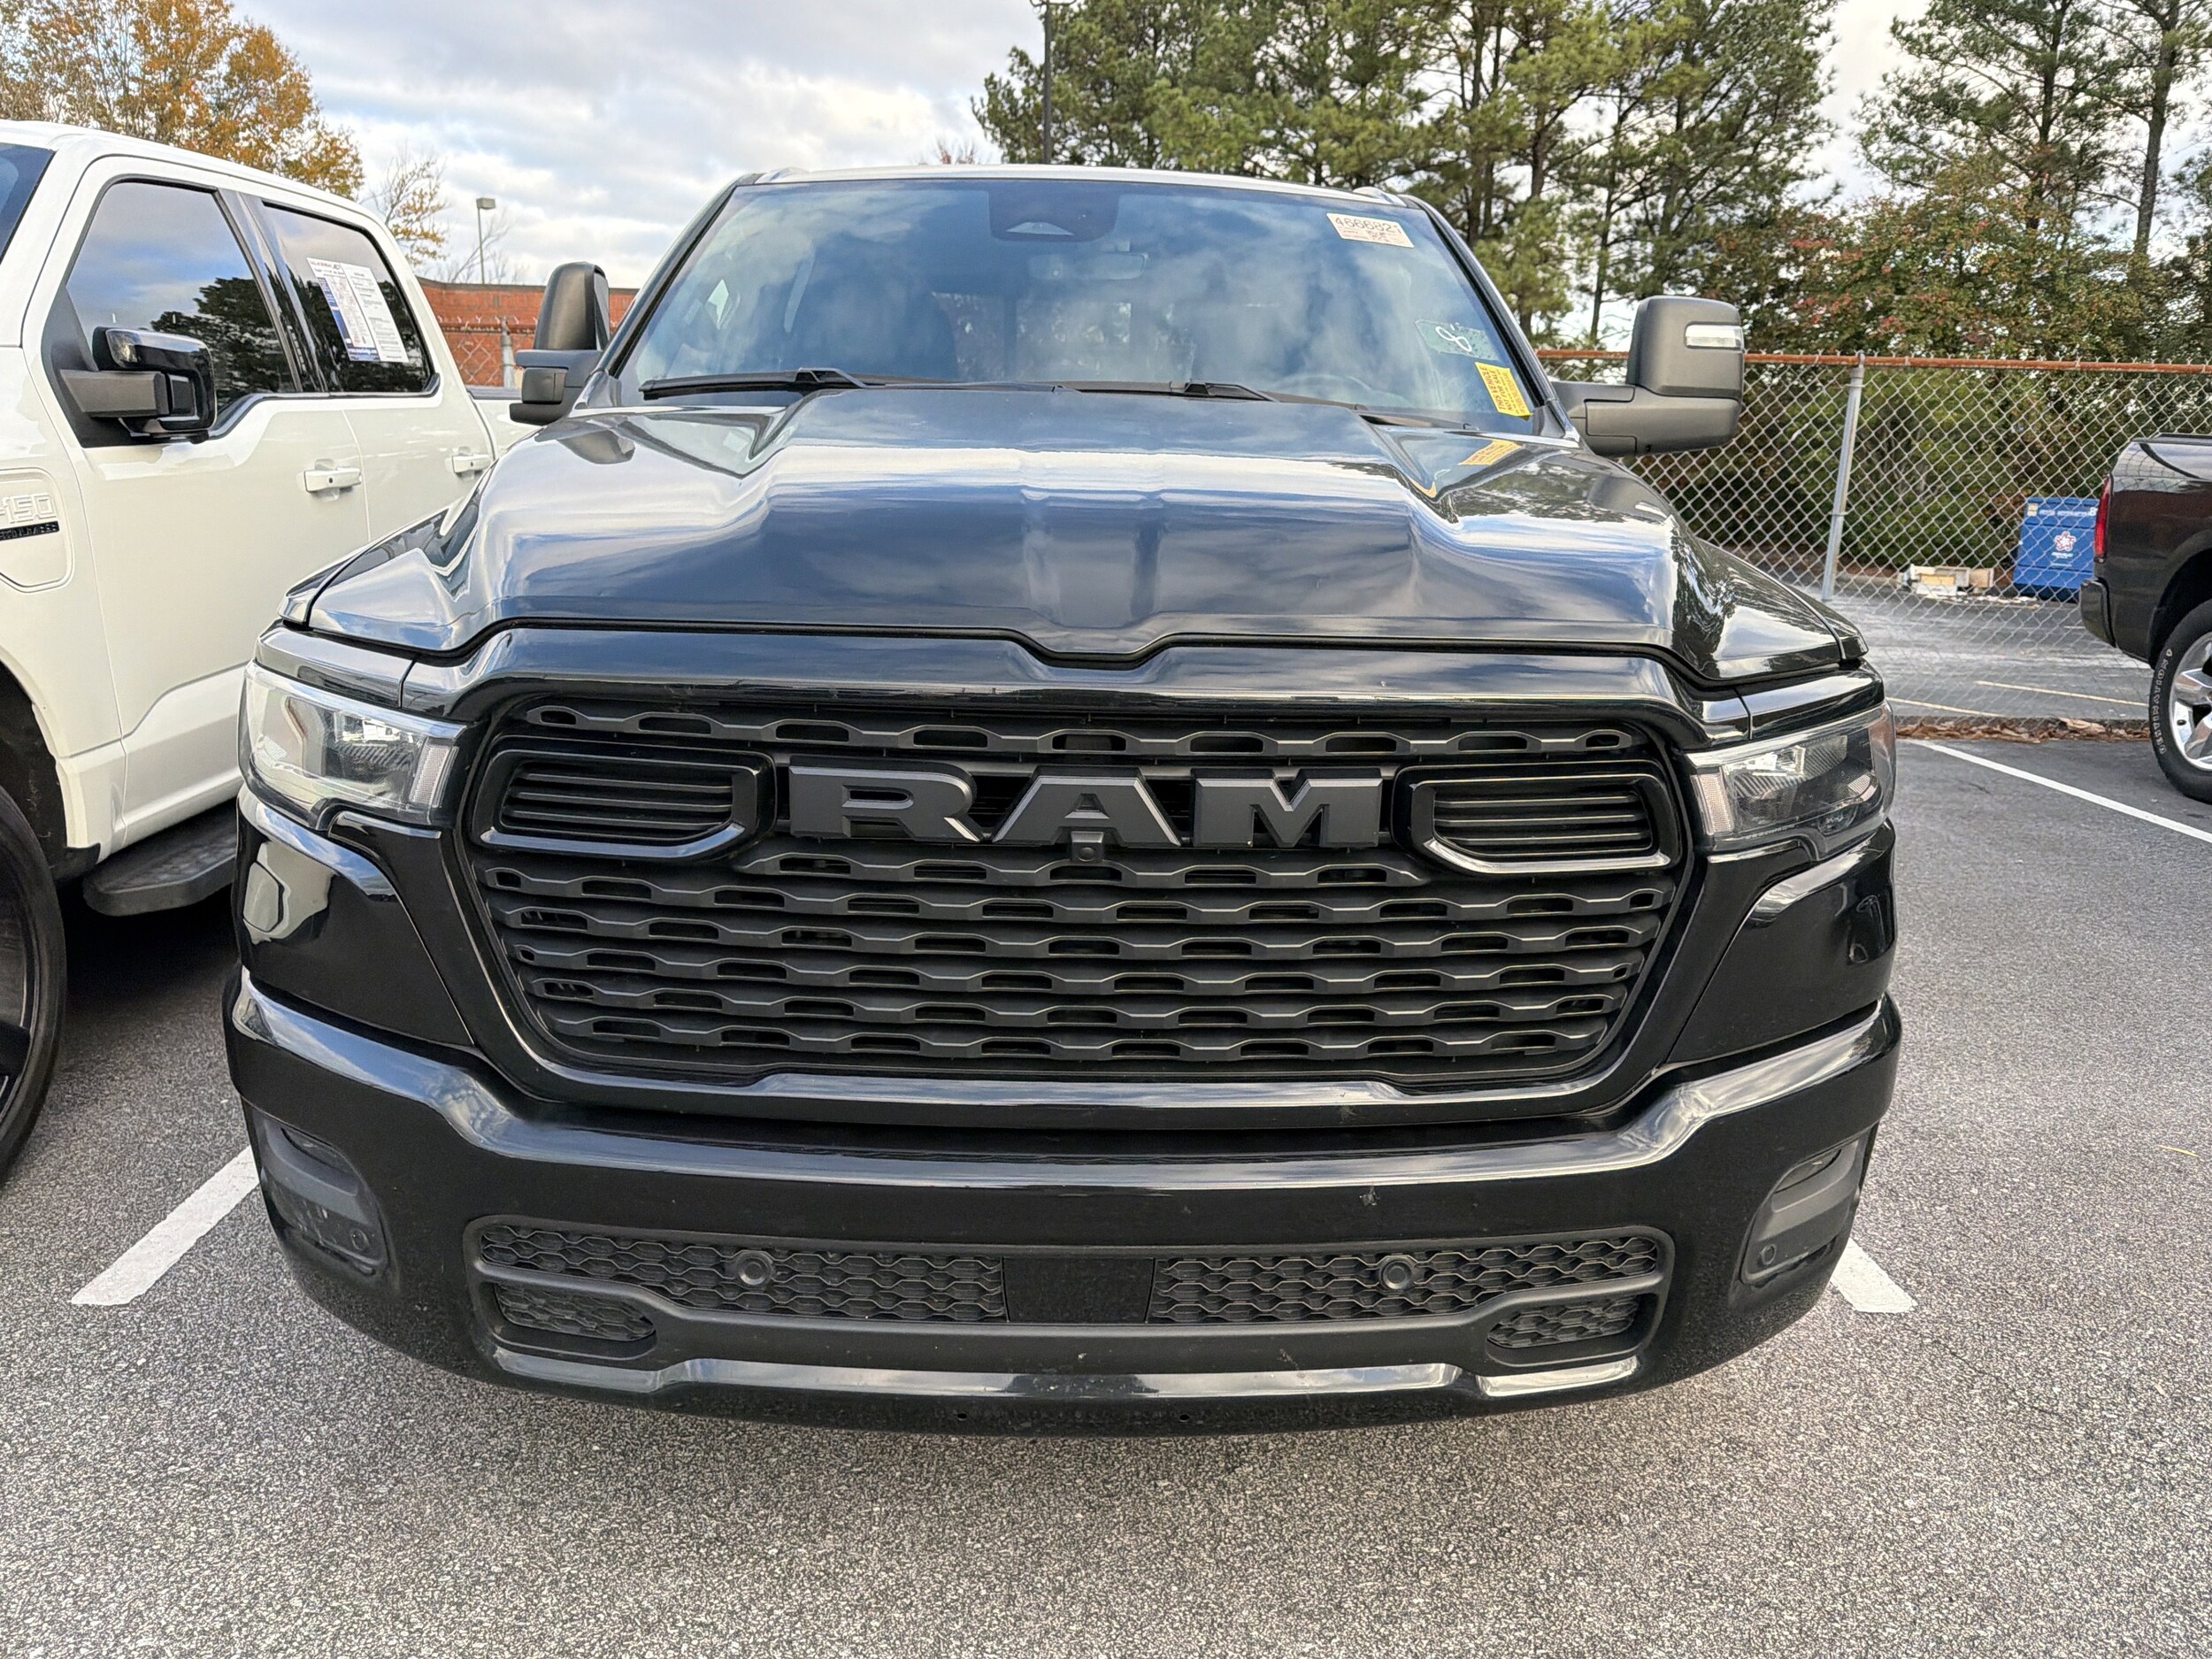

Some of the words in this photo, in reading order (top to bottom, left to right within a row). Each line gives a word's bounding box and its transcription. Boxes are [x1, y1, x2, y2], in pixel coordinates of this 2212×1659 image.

[0, 492, 57, 524] -150
[2151, 658, 2169, 755] DESTINATION
[788, 759, 1384, 848] RAM
